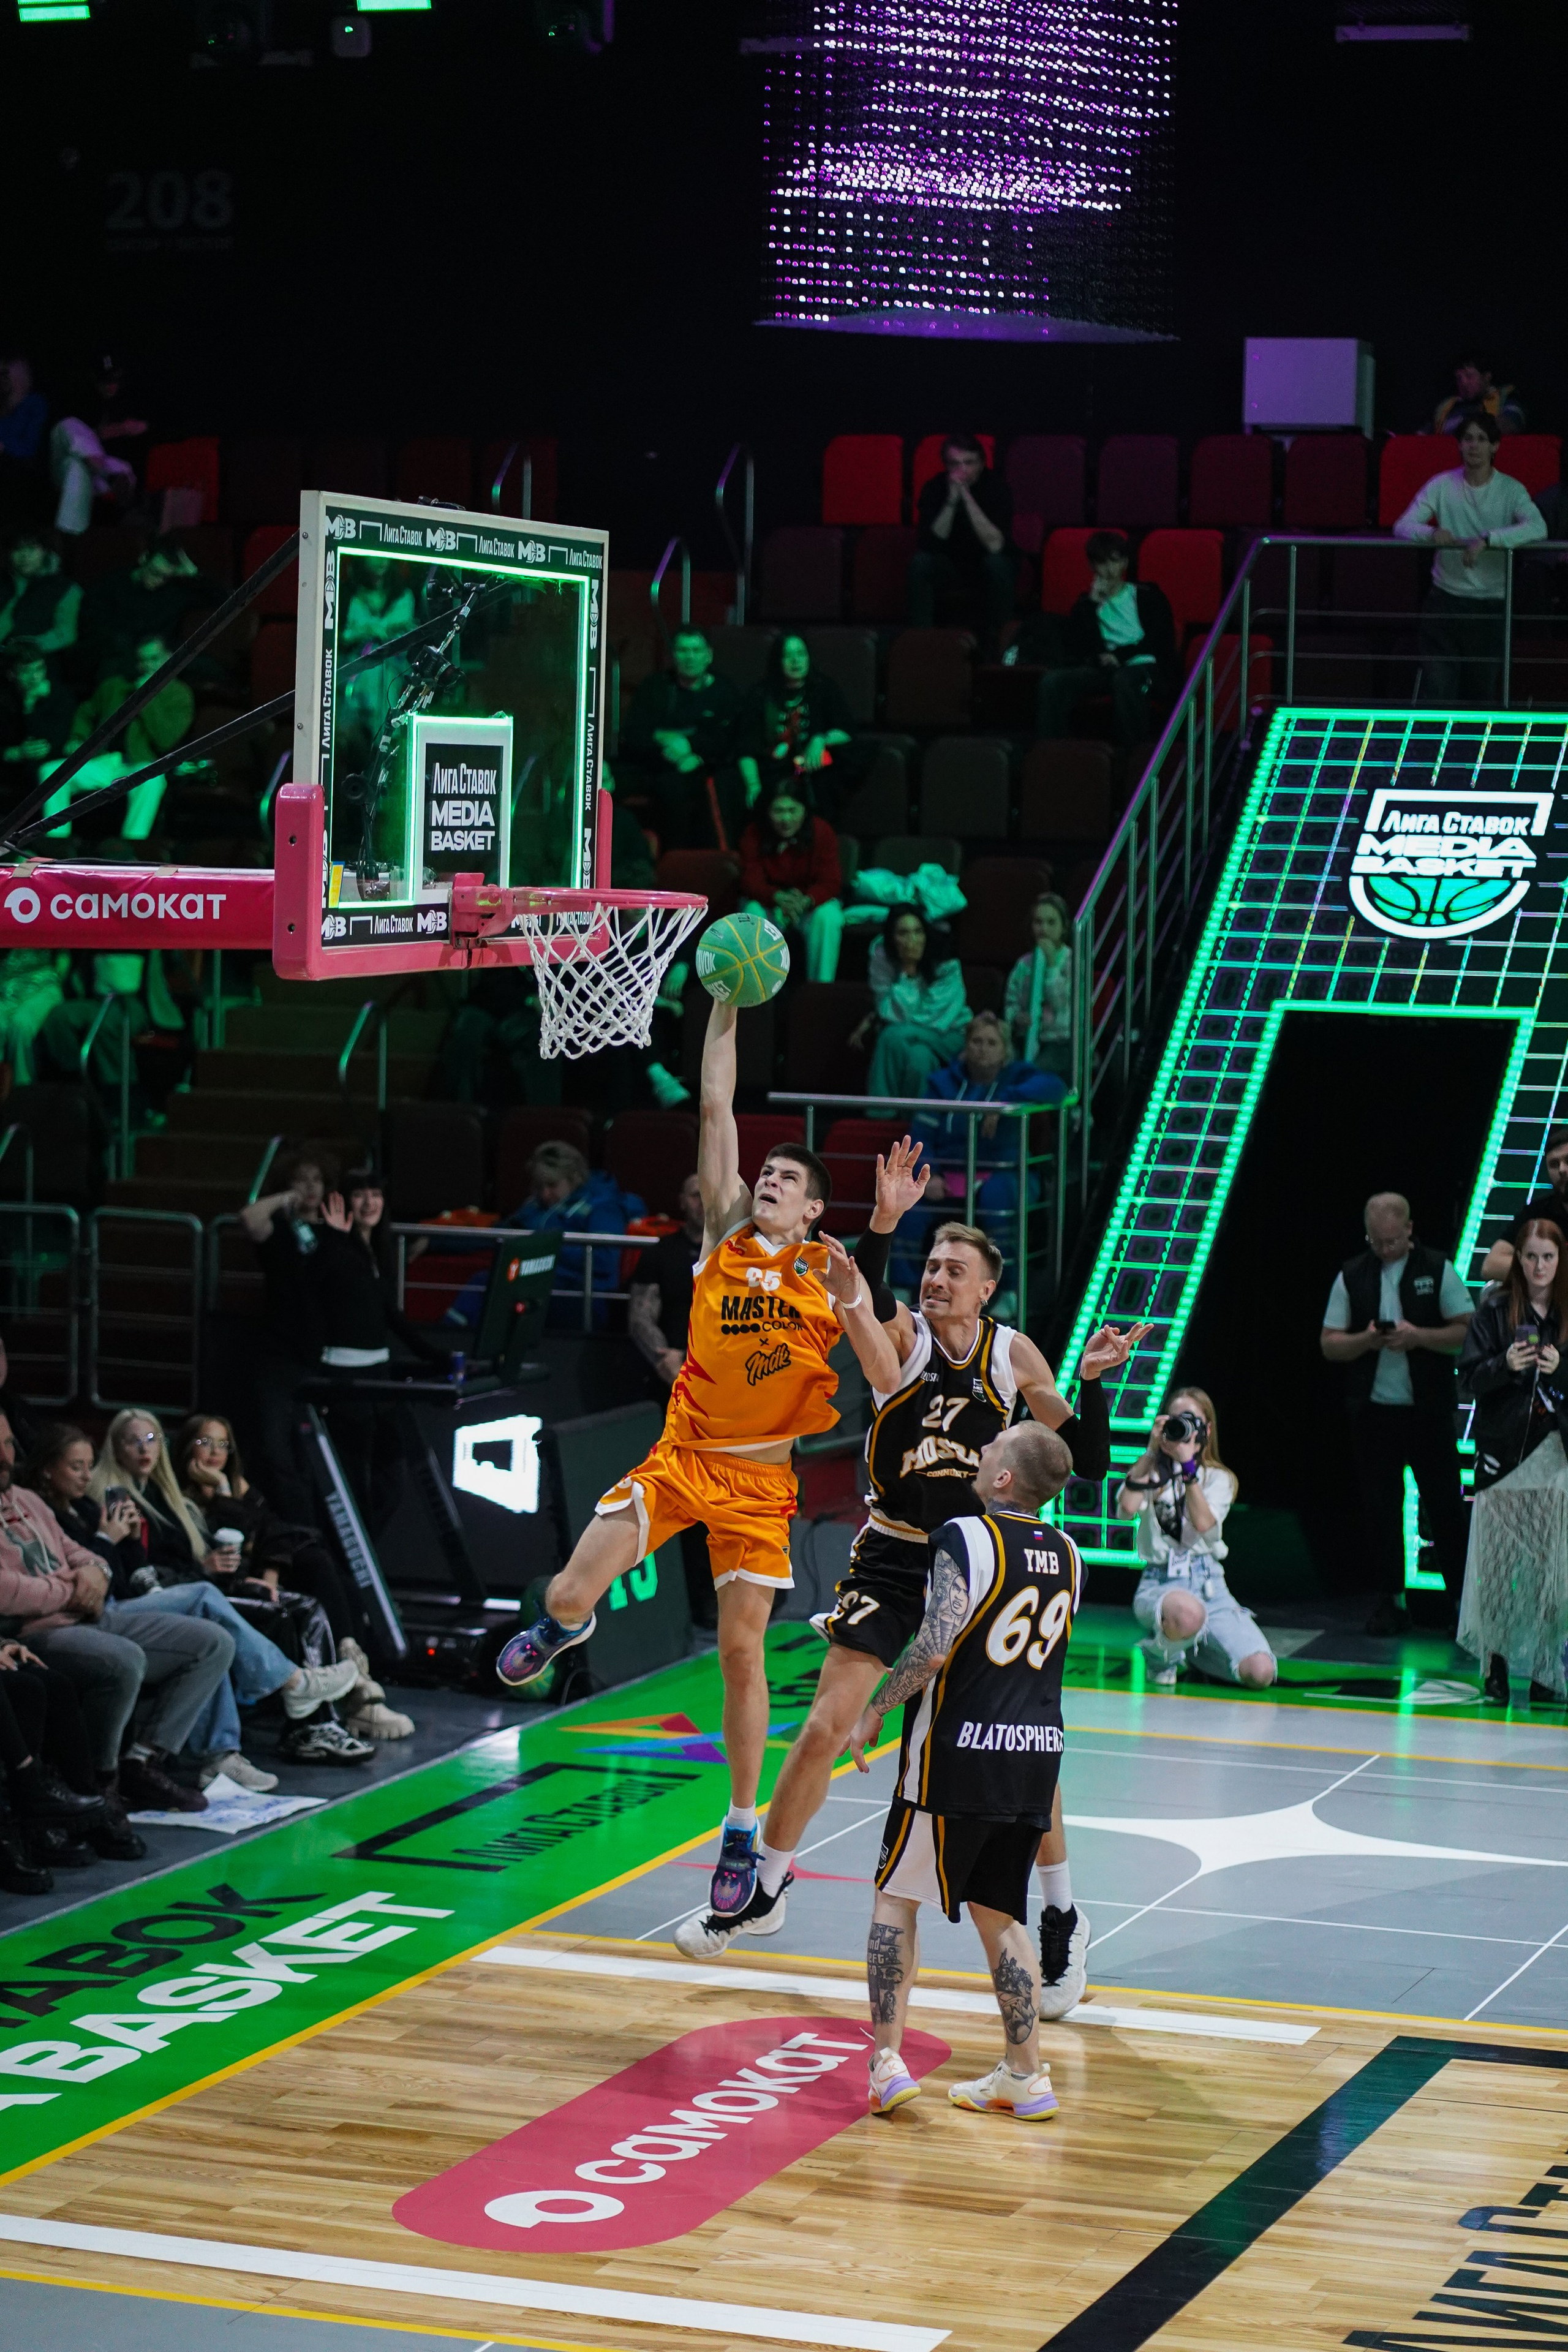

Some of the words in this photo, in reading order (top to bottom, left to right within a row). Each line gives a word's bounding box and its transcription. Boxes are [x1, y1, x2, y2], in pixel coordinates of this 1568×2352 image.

[105, 168, 234, 230] 208
[431, 800, 496, 827] MEDIA
[431, 830, 496, 851] BASKET
[1357, 834, 1537, 861] MEDIA
[1351, 855, 1537, 878] BASKET
[921, 1394, 971, 1432] 27
[986, 1585, 1071, 1670] 69
[0, 1890, 456, 2083] BASKET
